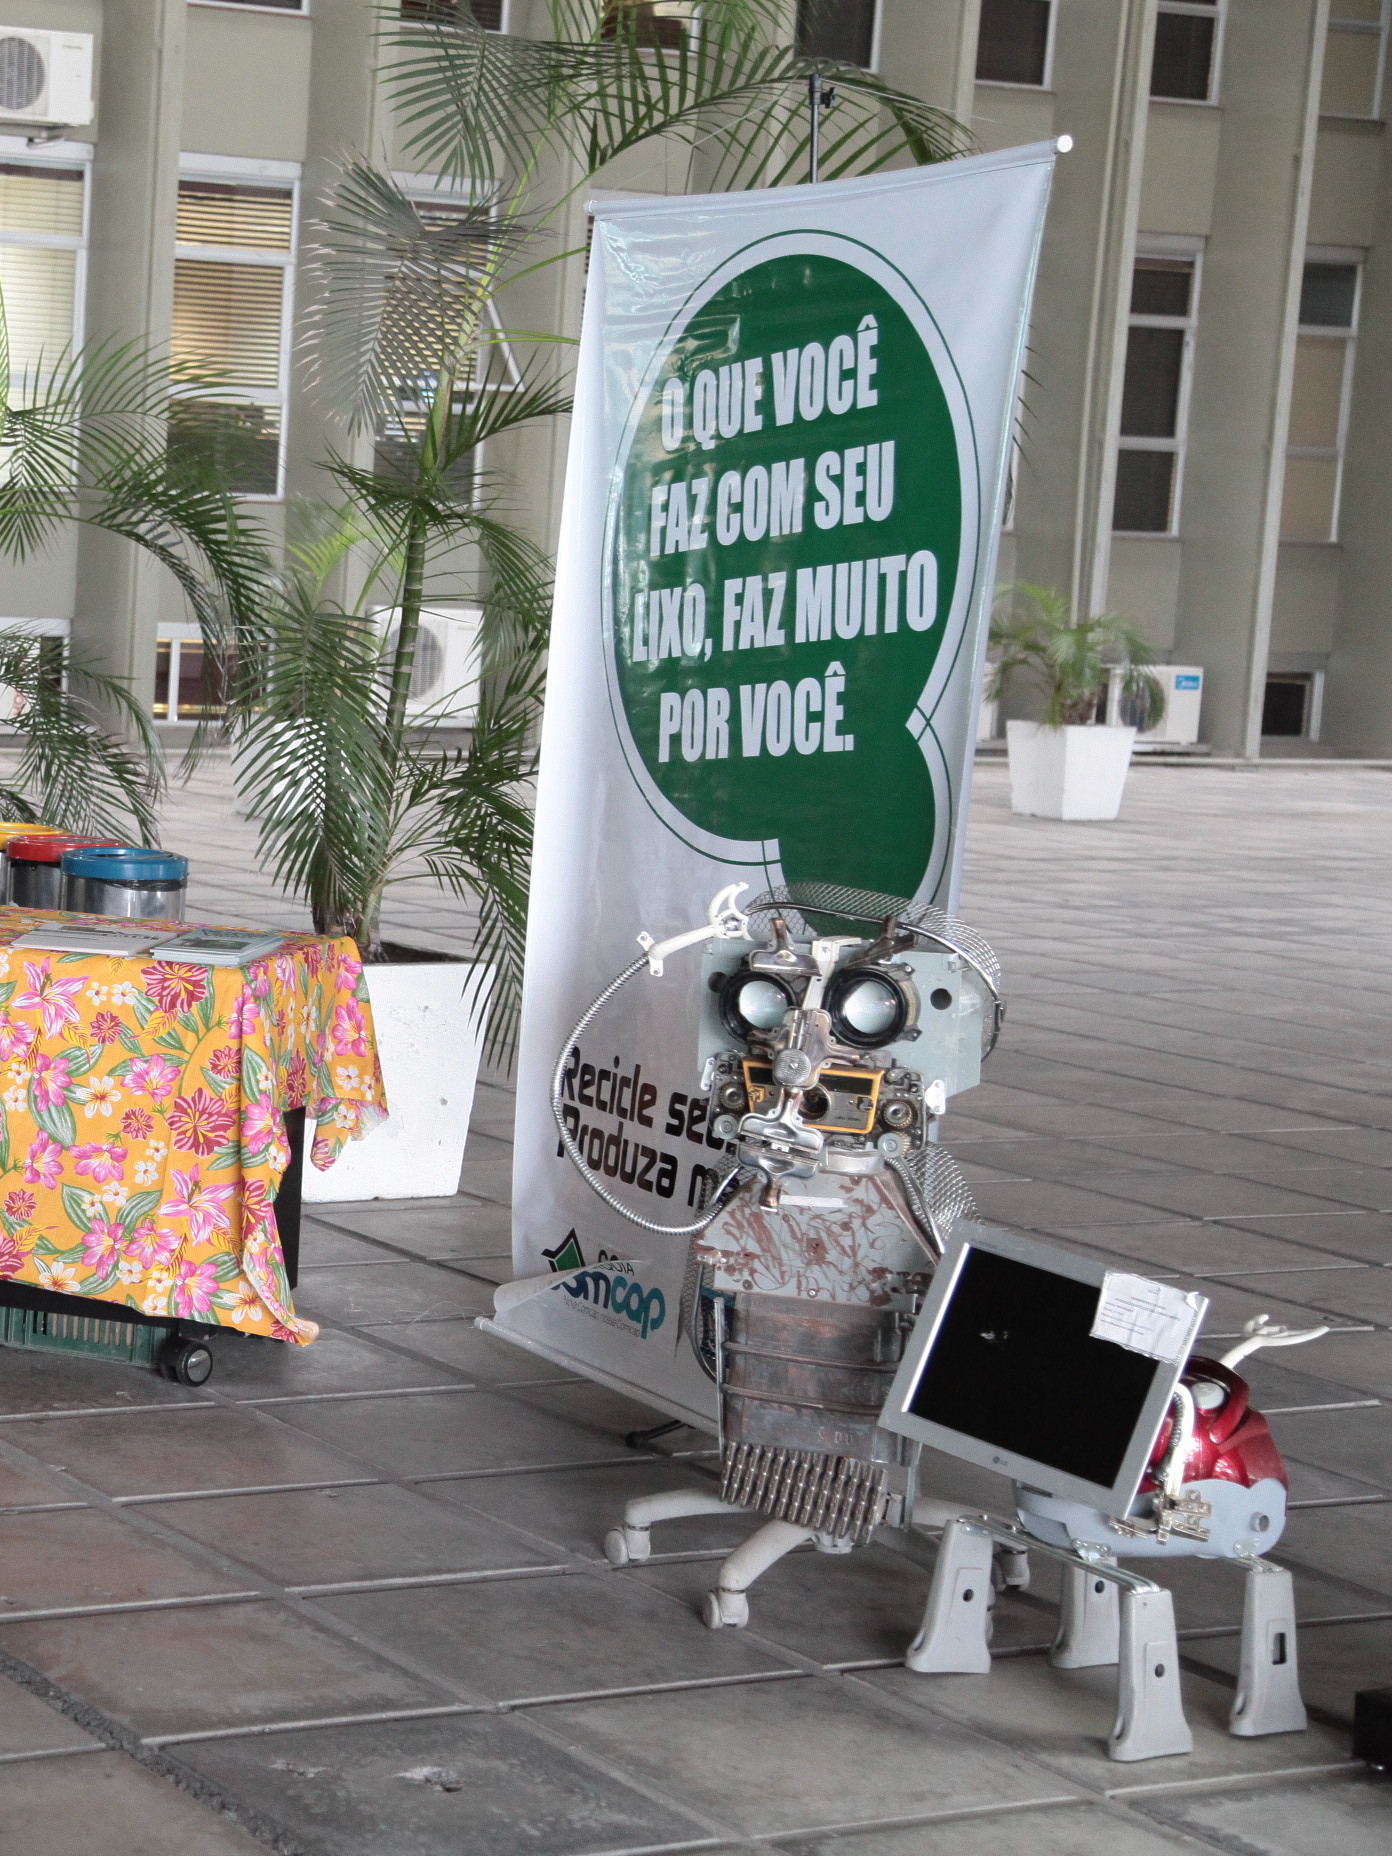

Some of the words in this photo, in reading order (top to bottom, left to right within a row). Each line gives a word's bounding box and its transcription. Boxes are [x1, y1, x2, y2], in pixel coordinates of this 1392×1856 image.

[660, 377, 684, 452] O
[692, 357, 763, 451] QUE
[771, 314, 878, 427] VOCÊ
[650, 477, 709, 557] FAZ
[716, 457, 806, 546] COM
[813, 440, 896, 530] SEU
[632, 582, 714, 662] LIXO,
[722, 571, 787, 652] FAZ
[795, 550, 938, 644] MUITO
[658, 687, 729, 763] POR
[739, 661, 855, 758] VOCÊ.
[560, 1045, 657, 1128] Recicle
[557, 1103, 678, 1199] Produza
